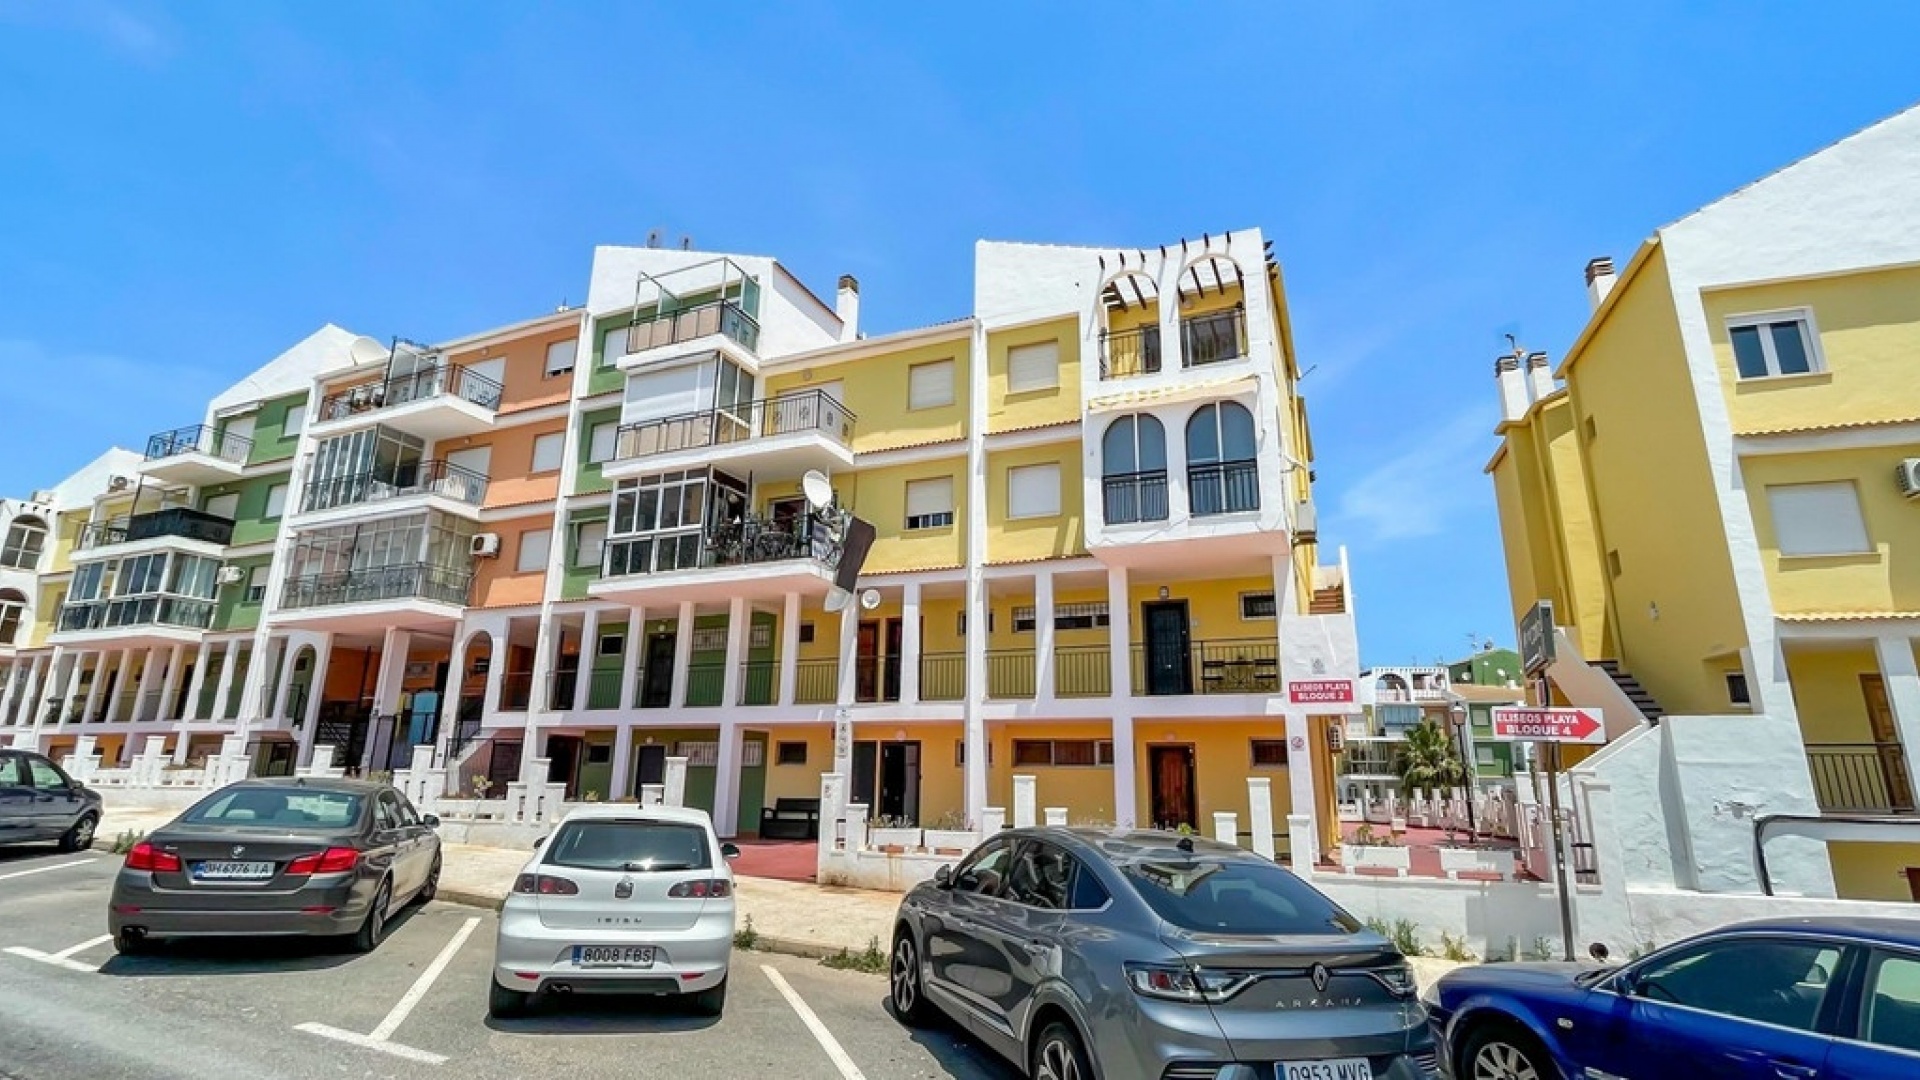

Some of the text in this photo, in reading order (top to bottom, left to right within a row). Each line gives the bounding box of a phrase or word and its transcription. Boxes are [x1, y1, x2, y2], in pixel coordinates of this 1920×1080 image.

[1291, 682, 1350, 692] ELISEOS PLAYA
[1298, 691, 1337, 701] BLOQUE
[1496, 712, 1579, 724] ELISEOS PLAYA
[1506, 724, 1572, 736] BLOQUE 4
[583, 947, 652, 963] 8008 FBS
[1289, 1064, 1333, 1080] 0953
